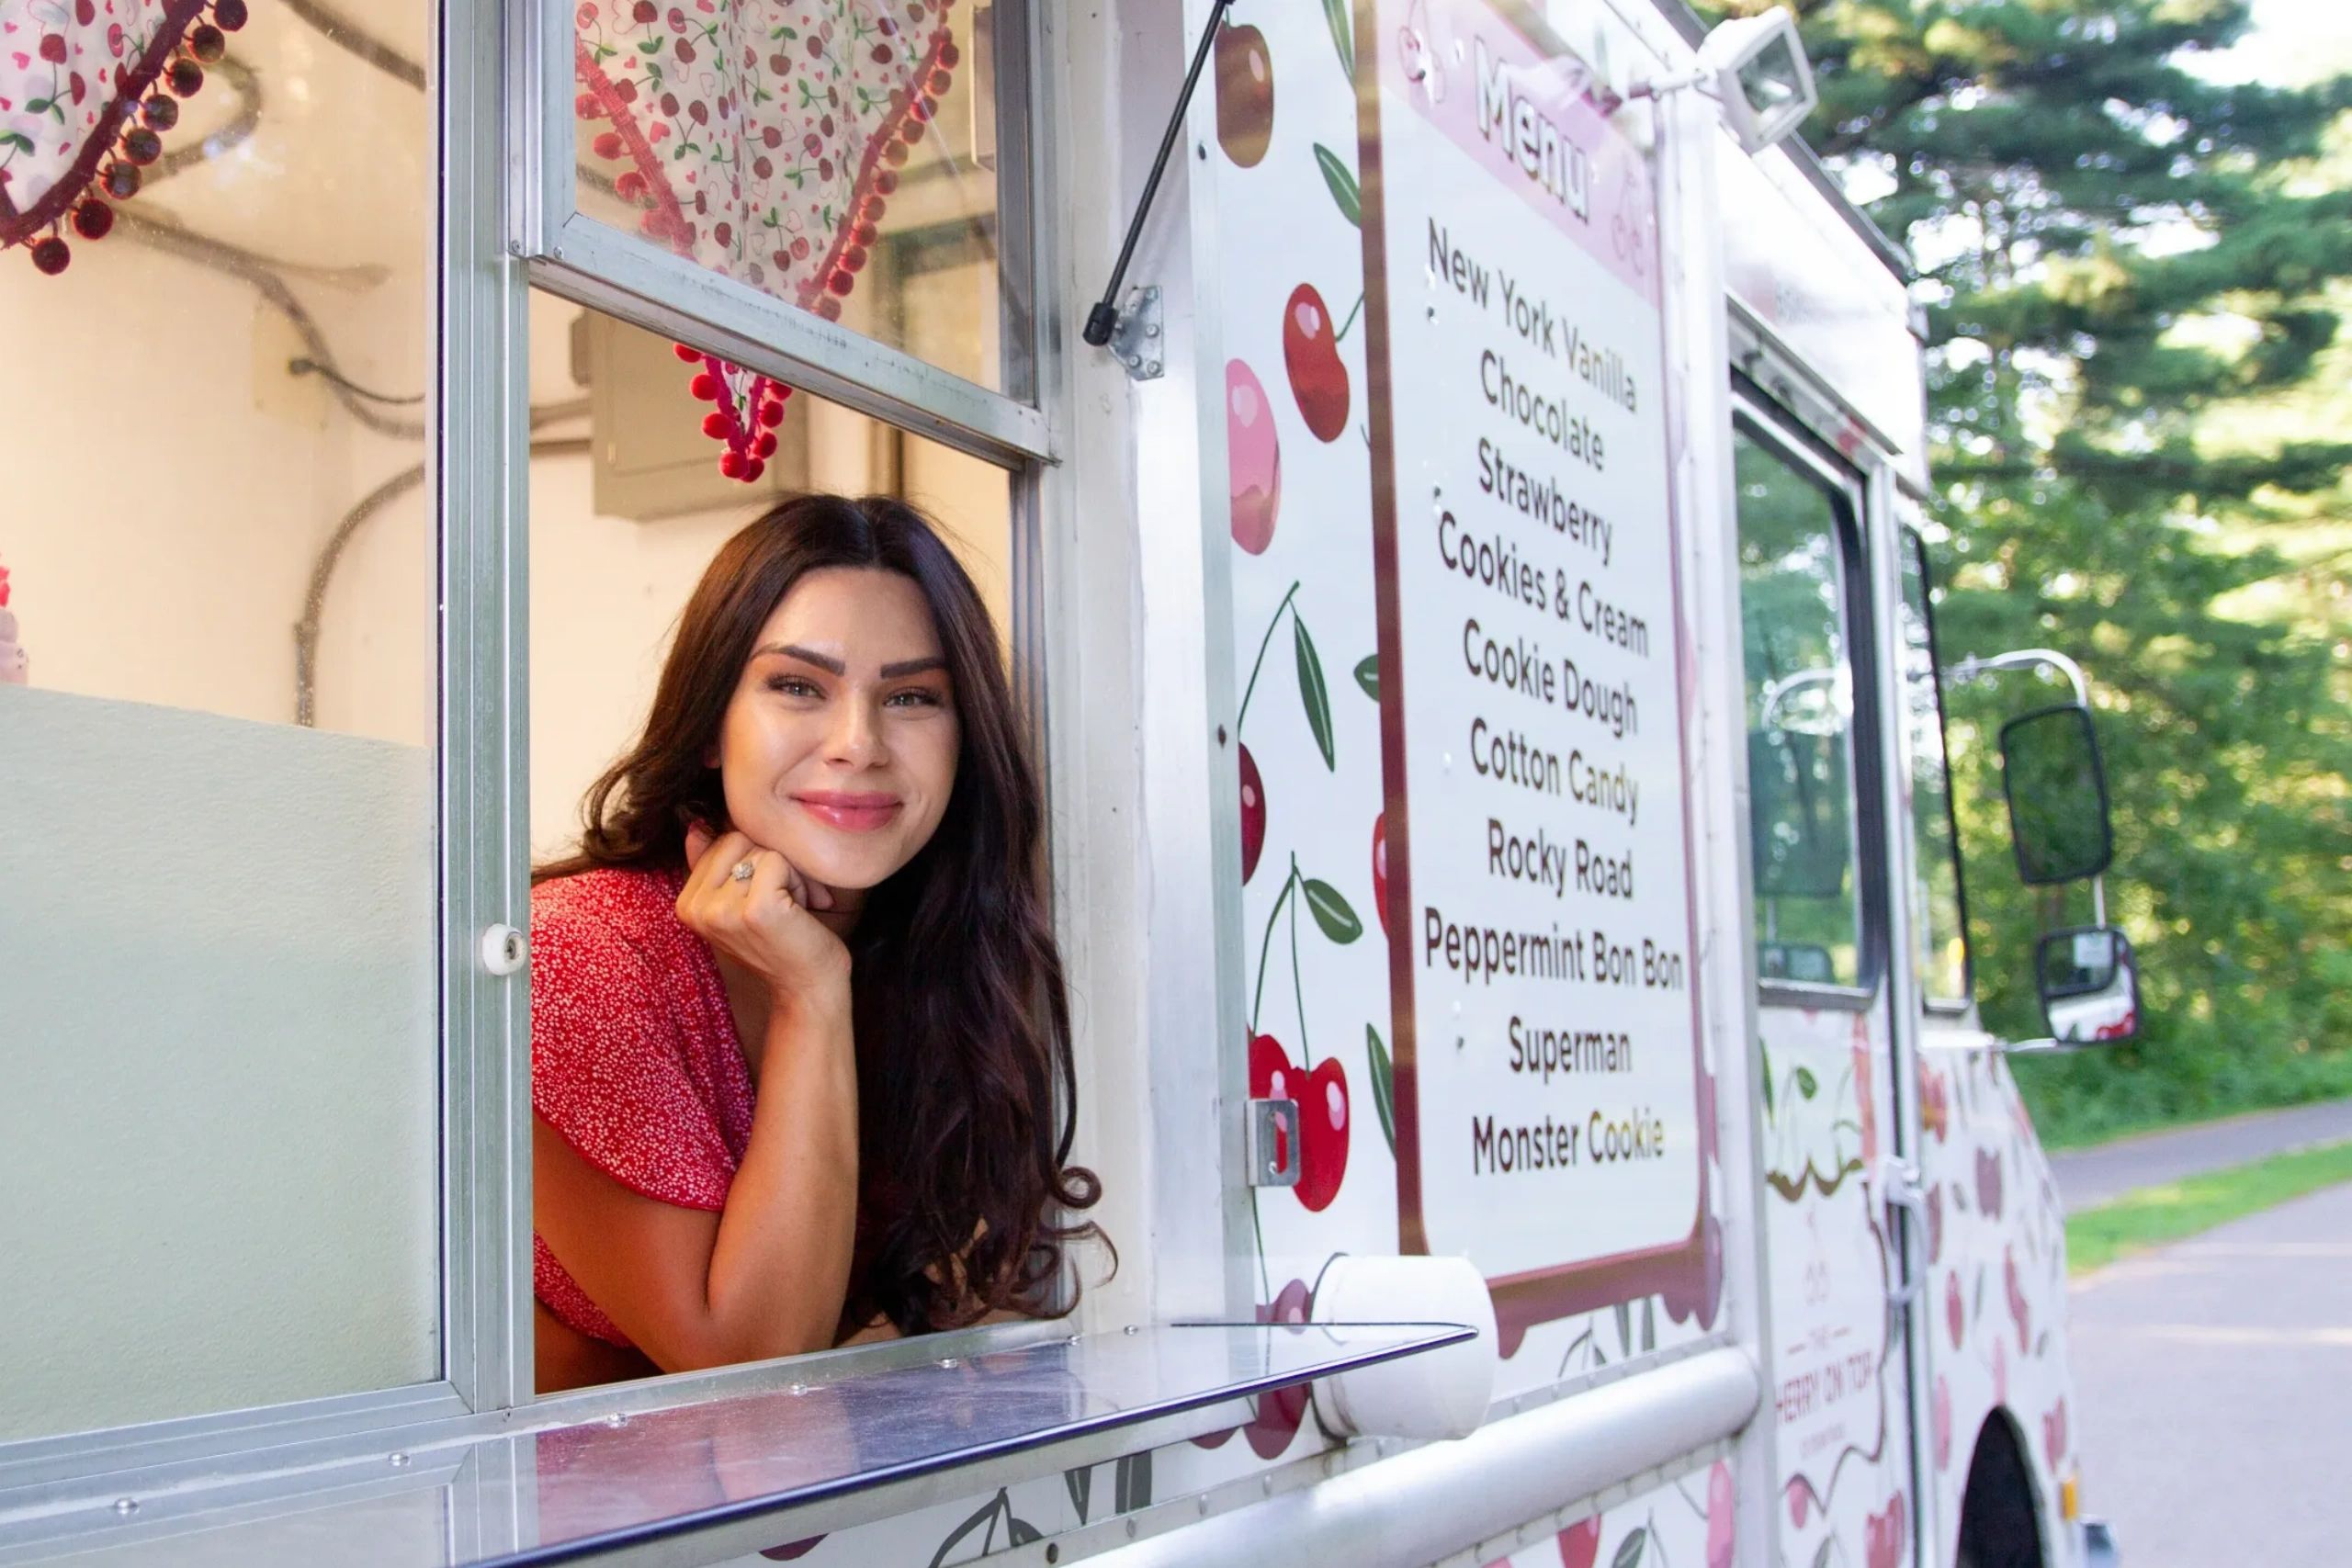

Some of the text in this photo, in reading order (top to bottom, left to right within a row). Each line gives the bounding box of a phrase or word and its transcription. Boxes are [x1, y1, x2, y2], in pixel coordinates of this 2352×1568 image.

[1474, 34, 1589, 226] Menu
[1429, 217, 1636, 414] New York Vanilla
[1481, 349, 1604, 471] Chocolate
[1478, 436, 1612, 567] Strawberry
[1439, 511, 1648, 658] Cookies & Cream
[1464, 618, 1638, 739] Cookie Dough
[1470, 717, 1638, 827] Cotton Candy
[1487, 818, 1633, 899] Rocky Road
[1425, 907, 1683, 990] Peppermint Bon Bon
[1509, 1015, 1632, 1085] Superman
[1473, 1109, 1666, 1176] Monster Cookie
[1823, 1359, 1844, 1404] ON
[1847, 1351, 1872, 1391] TOP
